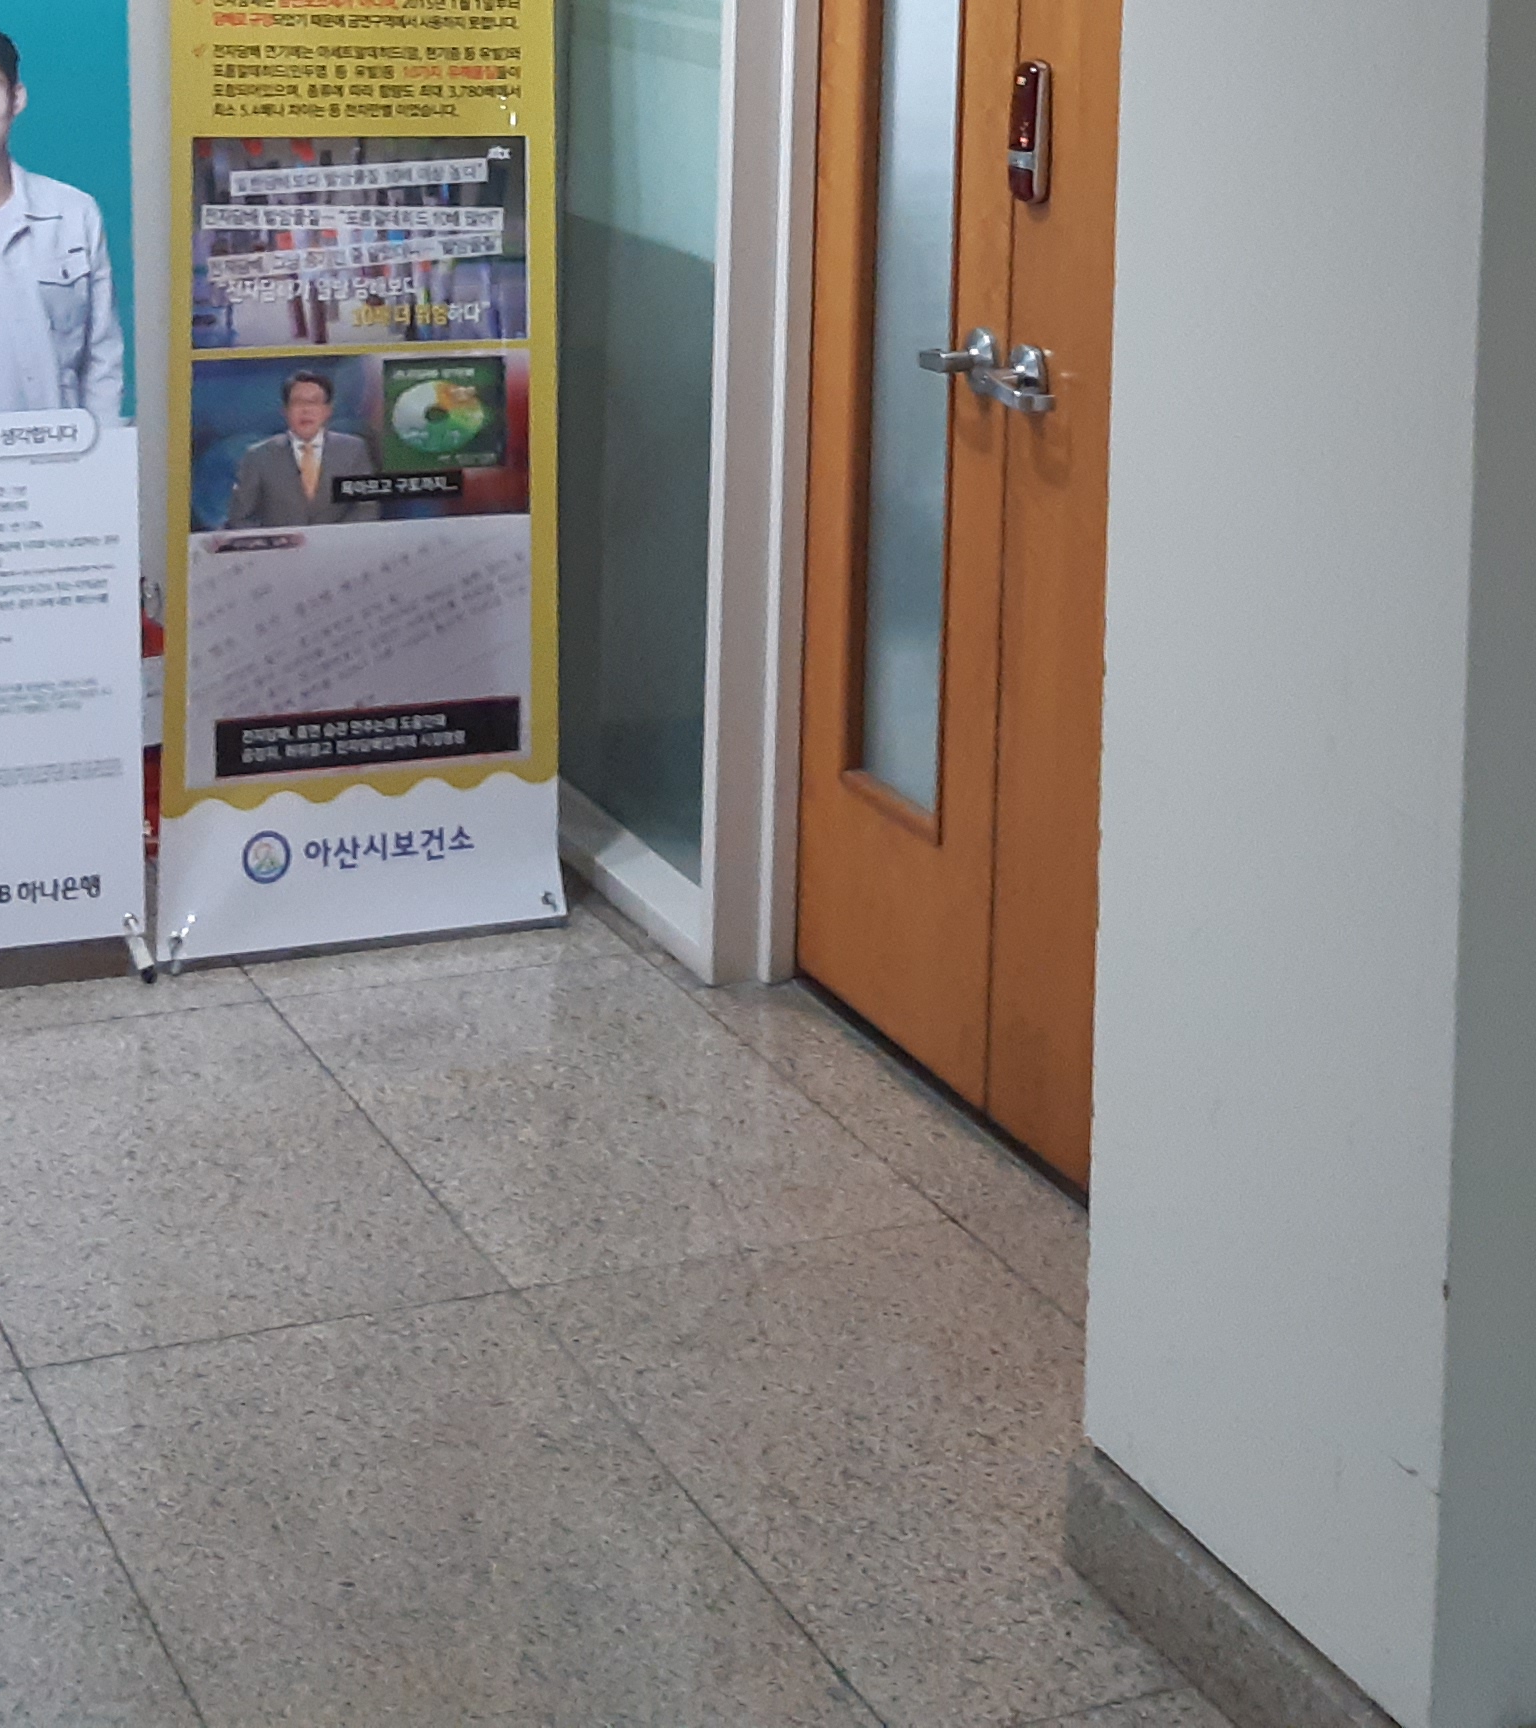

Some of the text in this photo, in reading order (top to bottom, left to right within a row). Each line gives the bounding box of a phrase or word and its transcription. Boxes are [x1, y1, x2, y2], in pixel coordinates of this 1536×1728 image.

[0, 425, 78, 446] 생각합니다
[303, 824, 475, 870] 아산시보건소
[17, 874, 102, 905] 하나은행
